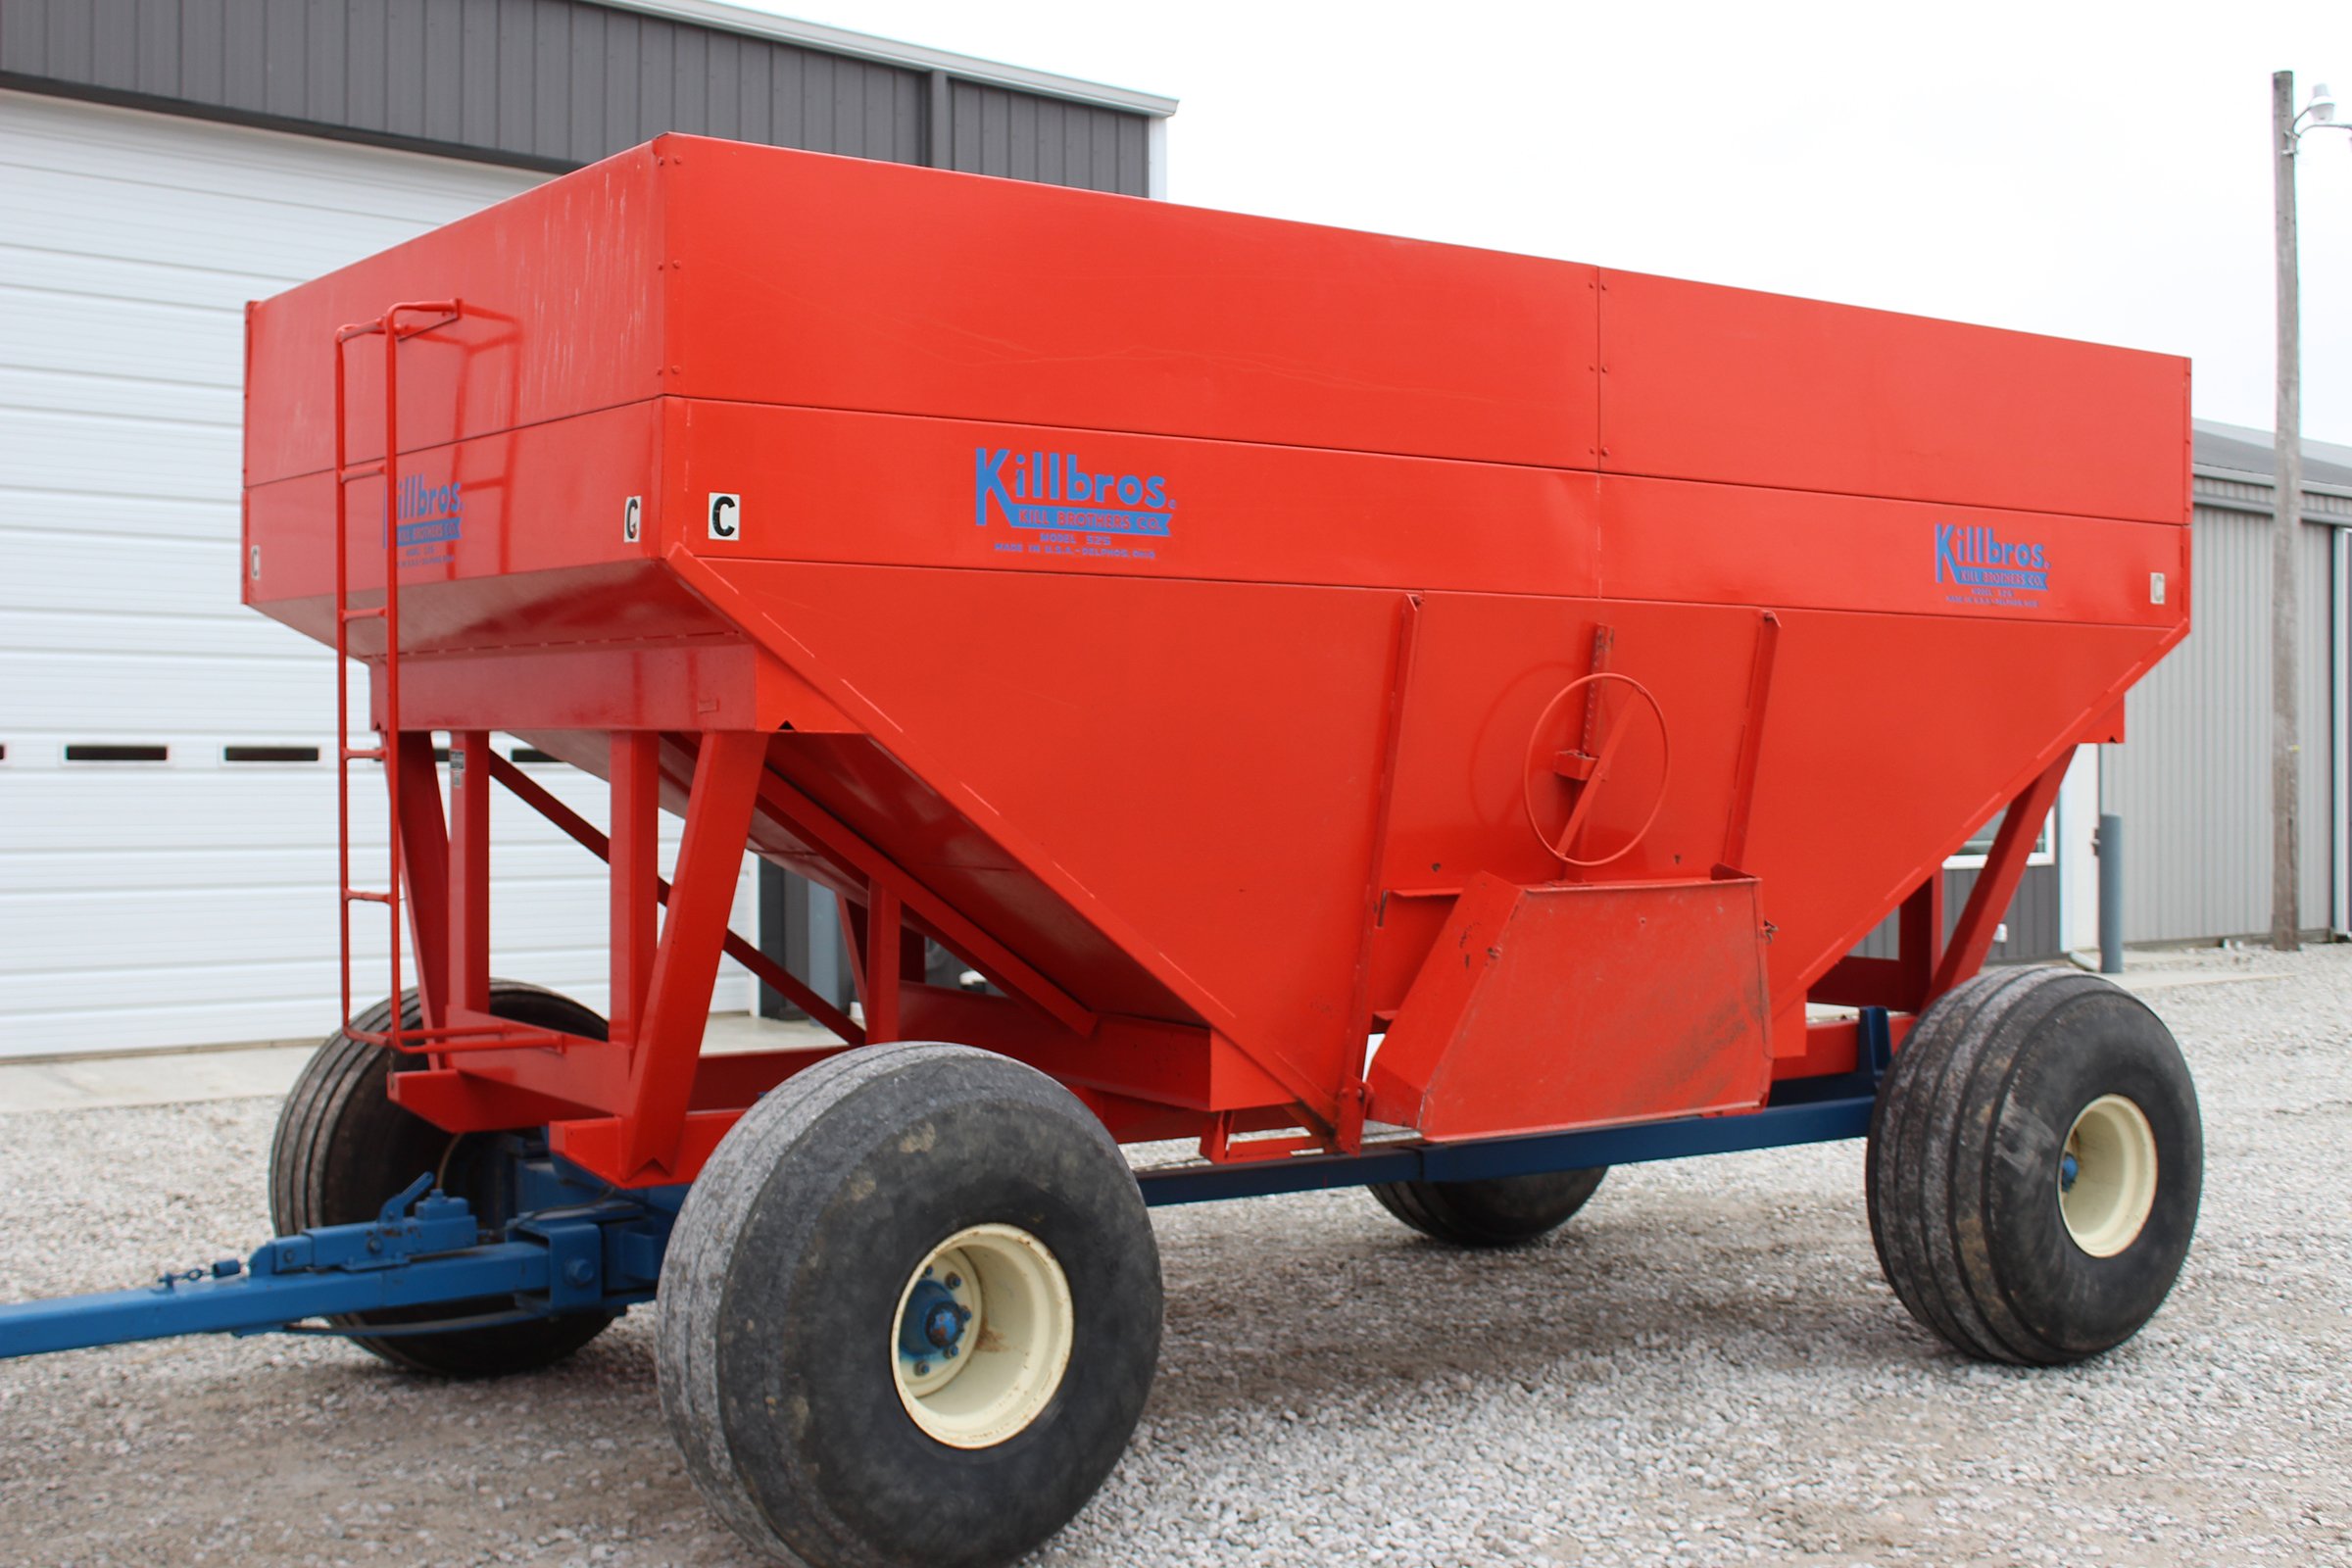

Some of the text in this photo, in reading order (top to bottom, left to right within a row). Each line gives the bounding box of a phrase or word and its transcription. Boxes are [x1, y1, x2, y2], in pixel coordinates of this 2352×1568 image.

[712, 496, 735, 537] C
[1018, 510, 1162, 531] KILL BROTHERS CO.
[1040, 533, 1076, 544] MODEL
[1028, 544, 1041, 553] IN
[1960, 569, 1979, 582] KILL
[1983, 571, 2025, 585] BROTHERS
